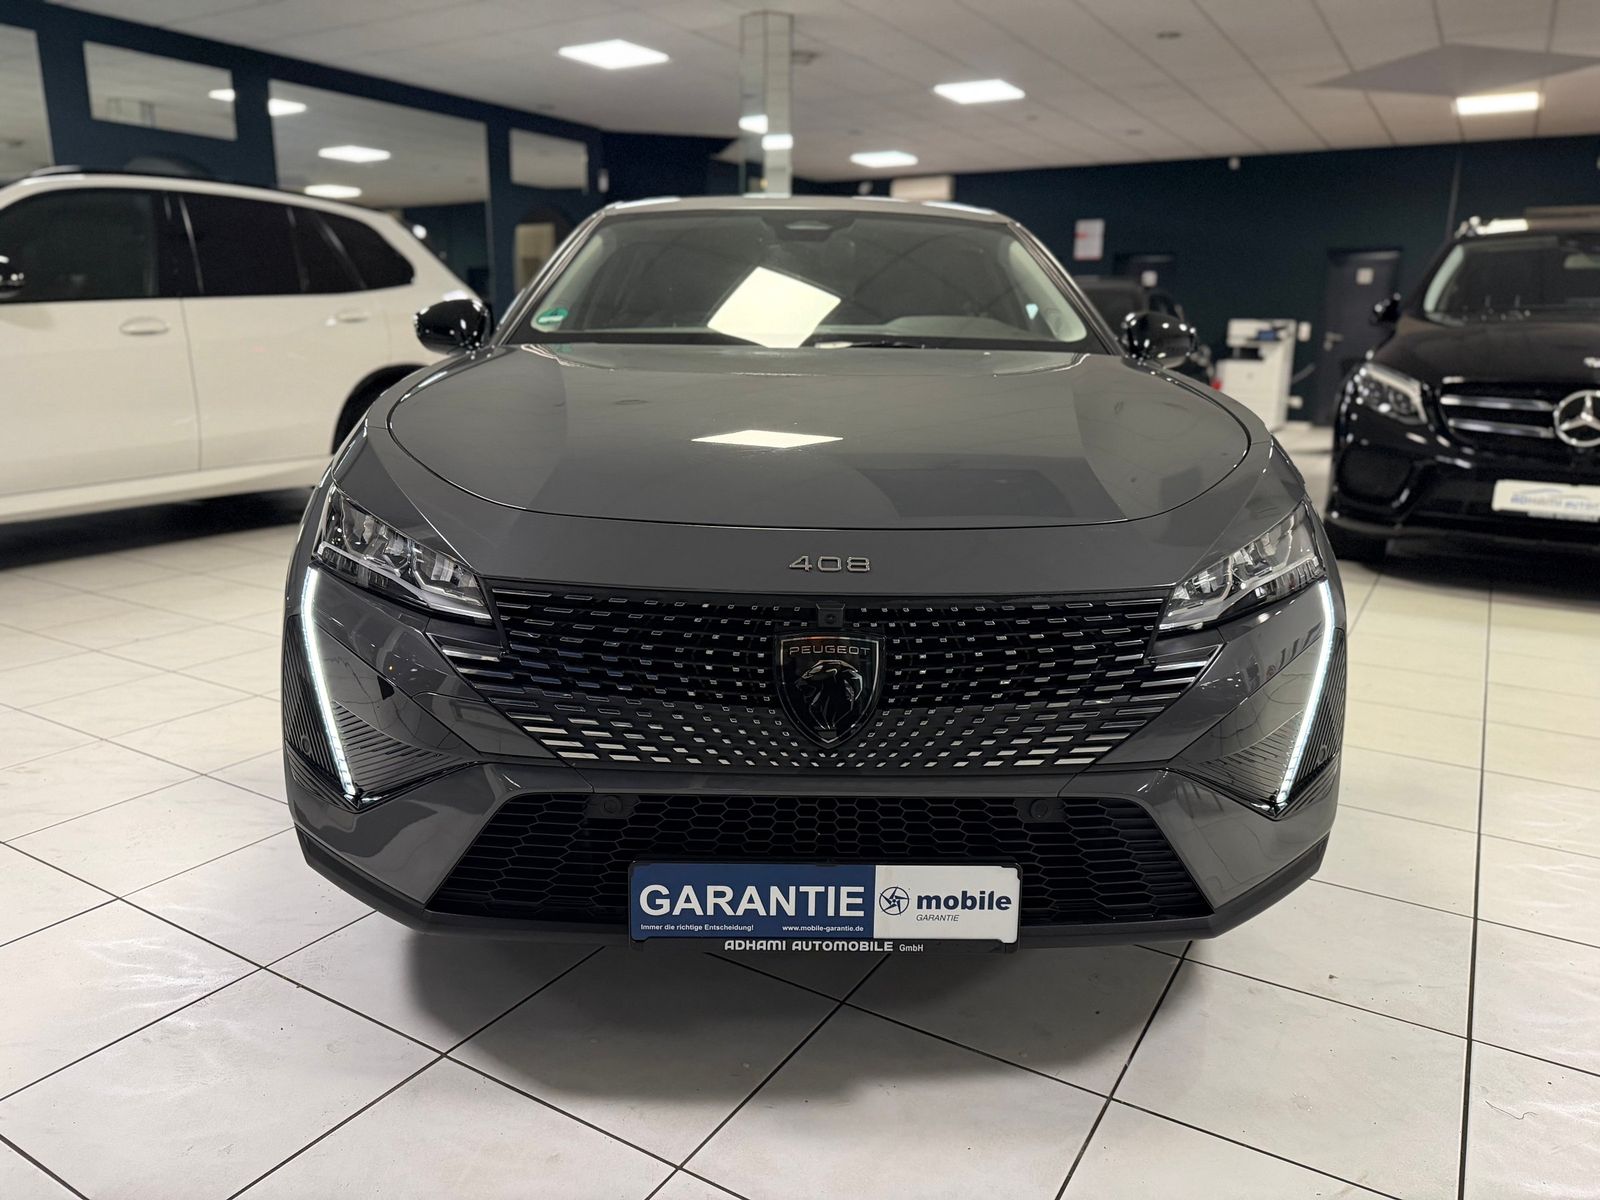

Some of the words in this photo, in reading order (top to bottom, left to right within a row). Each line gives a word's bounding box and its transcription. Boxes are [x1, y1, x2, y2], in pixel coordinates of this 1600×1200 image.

[789, 555, 871, 572] 408
[789, 645, 871, 656] PEUGEOT
[639, 884, 865, 917] GARANTIE
[916, 890, 1012, 911] mobile
[916, 914, 960, 922] GARANTIE
[640, 923, 663, 931] Immer
[664, 923, 676, 931] die
[676, 923, 703, 932] richtige
[704, 924, 754, 932] Entscheidung!
[782, 925, 864, 933] www.mobile-garantie.de
[724, 940, 786, 951] ADHAMI
[791, 941, 894, 952] AUTOMOBILE
[899, 943, 924, 953] GmbH
